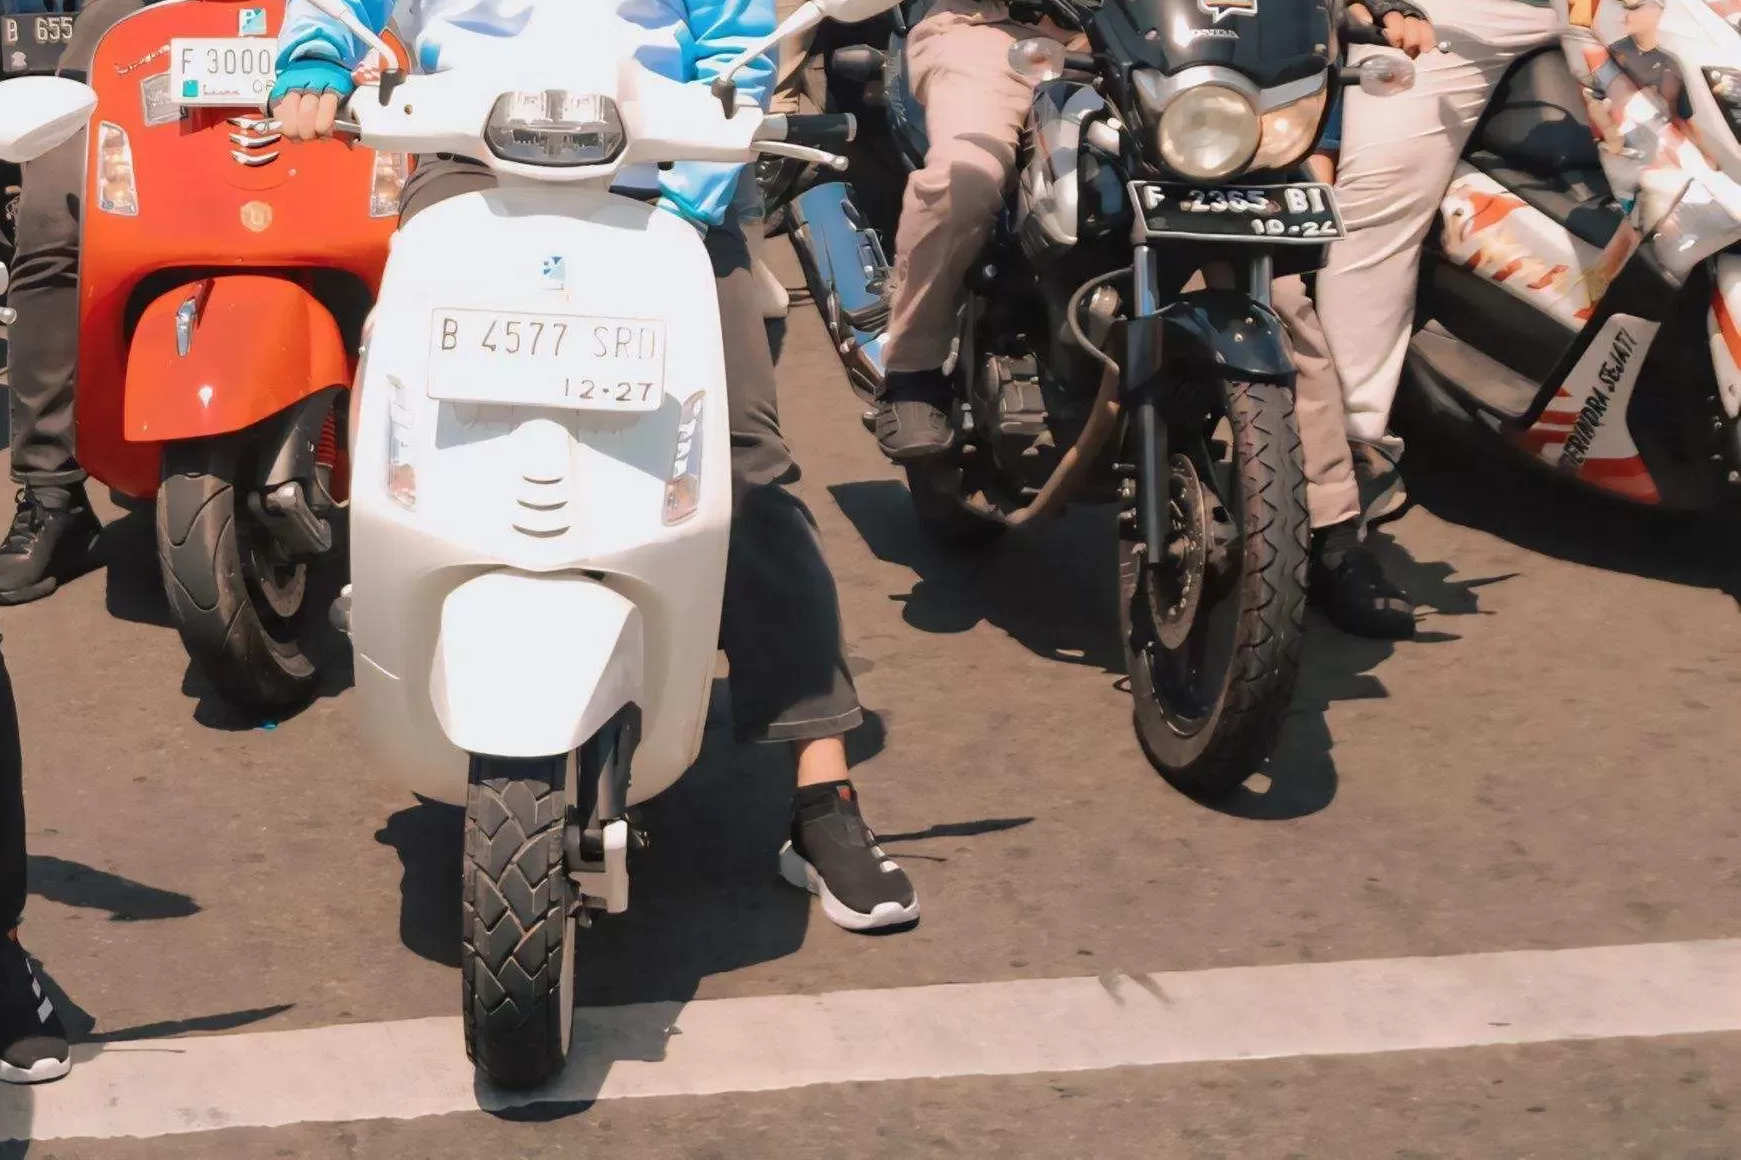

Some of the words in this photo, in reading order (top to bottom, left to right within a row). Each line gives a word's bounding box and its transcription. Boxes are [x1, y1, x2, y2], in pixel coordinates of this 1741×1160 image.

[6, 19, 18, 42] B
[180, 48, 194, 75] F
[207, 48, 270, 76] 3000
[1144, 185, 1165, 209] F
[1284, 188, 1325, 213] BI
[441, 317, 459, 351] B
[481, 319, 569, 357] 4577
